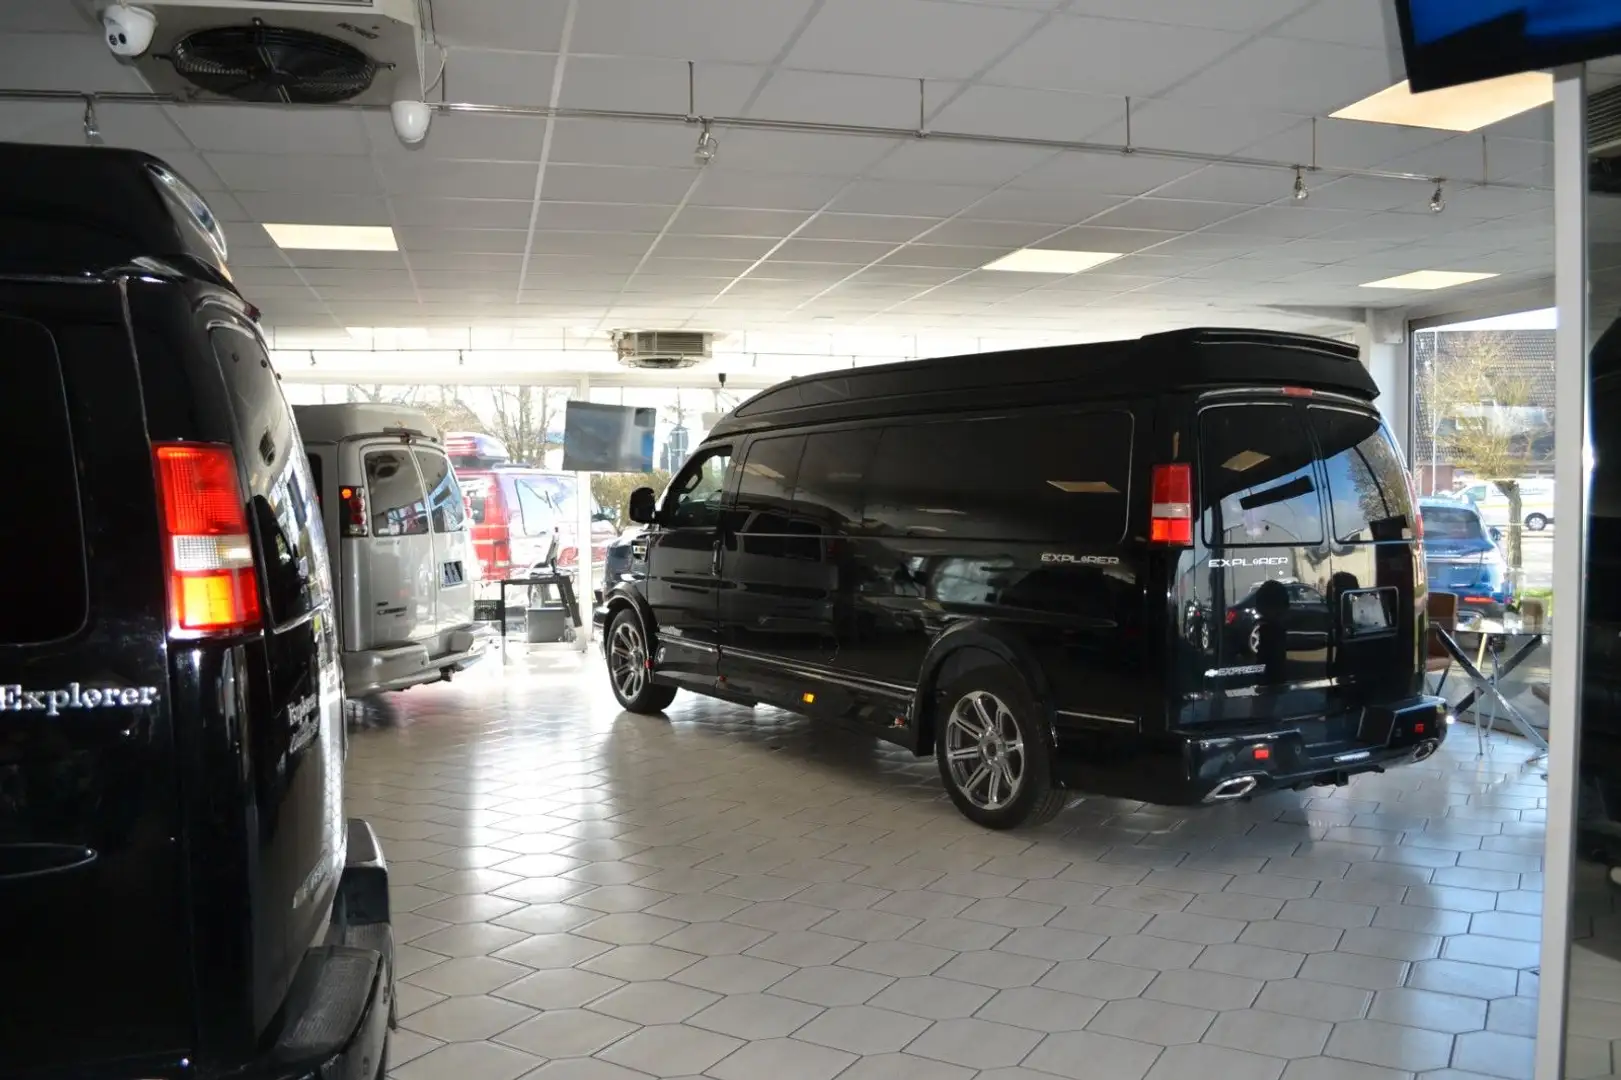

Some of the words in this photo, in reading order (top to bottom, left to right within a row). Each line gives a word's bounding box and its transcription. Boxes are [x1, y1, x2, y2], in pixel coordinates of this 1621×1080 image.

[1041, 553, 1120, 566] EXPLORER
[1208, 556, 1289, 568] EXPLORER
[1219, 664, 1267, 677] EXPRESS
[0, 681, 158, 716] Explorer
